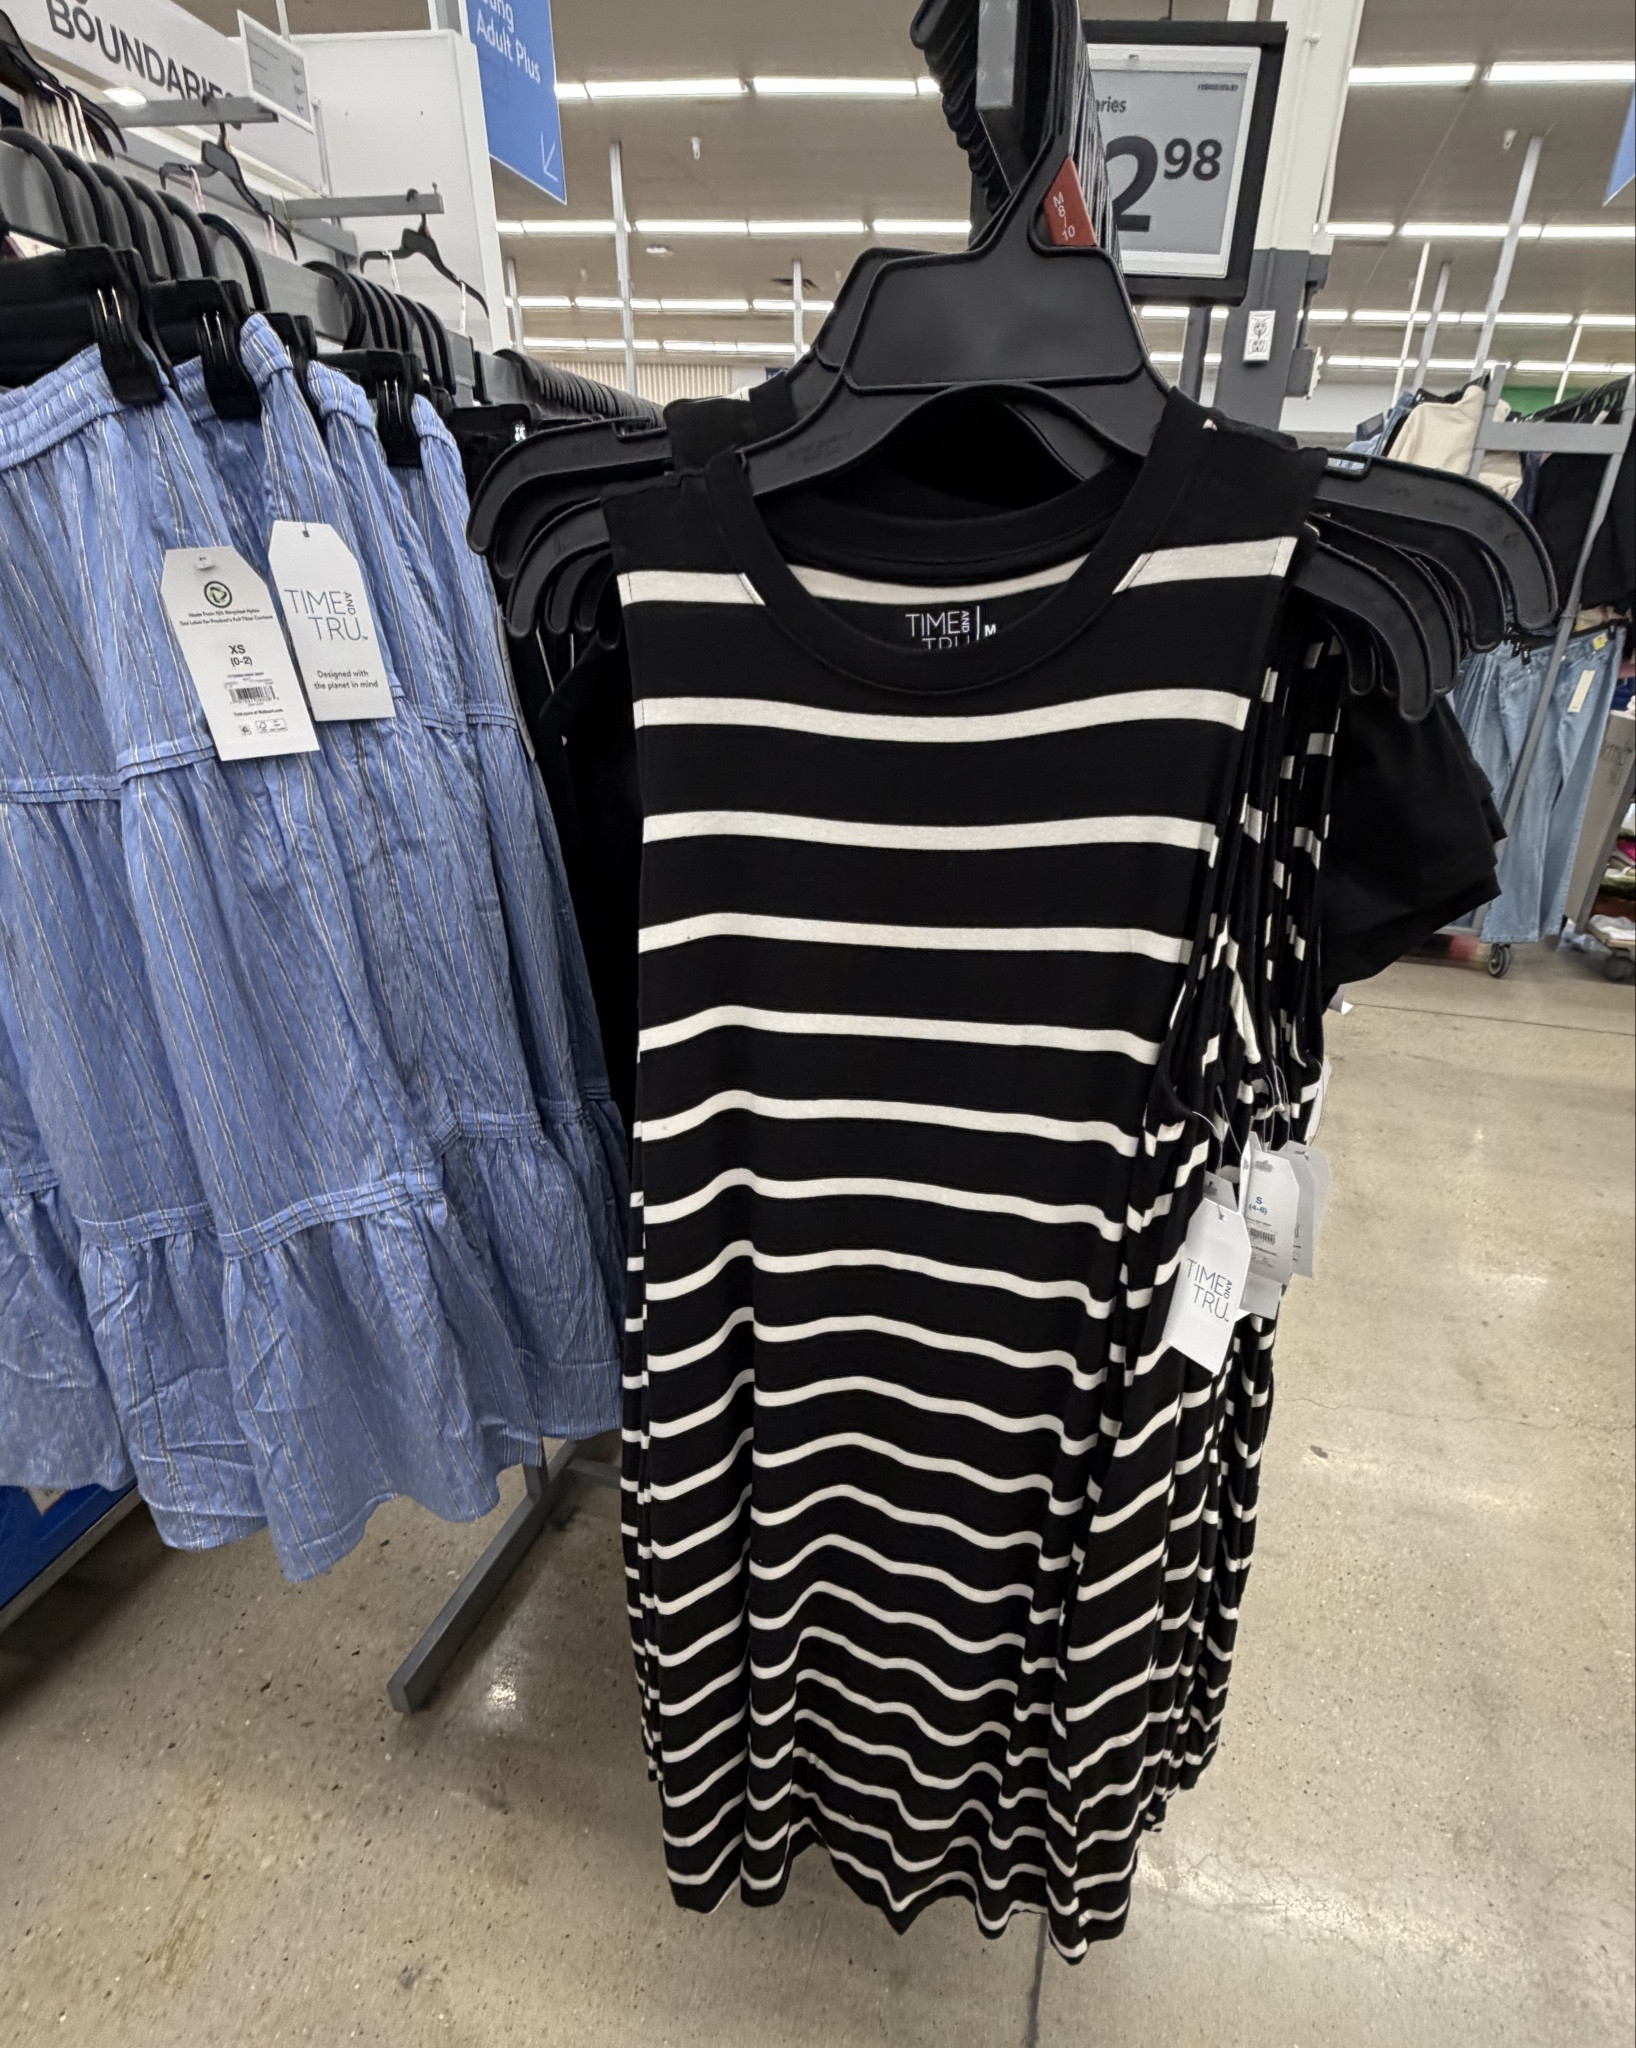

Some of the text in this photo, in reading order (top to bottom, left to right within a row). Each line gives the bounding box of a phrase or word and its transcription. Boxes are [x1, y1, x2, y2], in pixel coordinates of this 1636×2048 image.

[483, 0, 515, 34] ung
[476, 7, 541, 84] Adult Plus
[1163, 137, 1223, 181] 98
[1052, 191, 1065, 208] M
[284, 589, 356, 615] TIME AND
[308, 616, 361, 641] TRU
[905, 610, 997, 638] TIME AND M
[229, 644, 246, 655] XS
[230, 656, 253, 667] (0-2)
[314, 679, 378, 691] the planet in mind
[317, 669, 369, 680] Designed with
[1255, 1196, 1263, 1205] S
[1187, 1257, 1232, 1299] TIME AND
[1193, 1283, 1229, 1319] TRU
